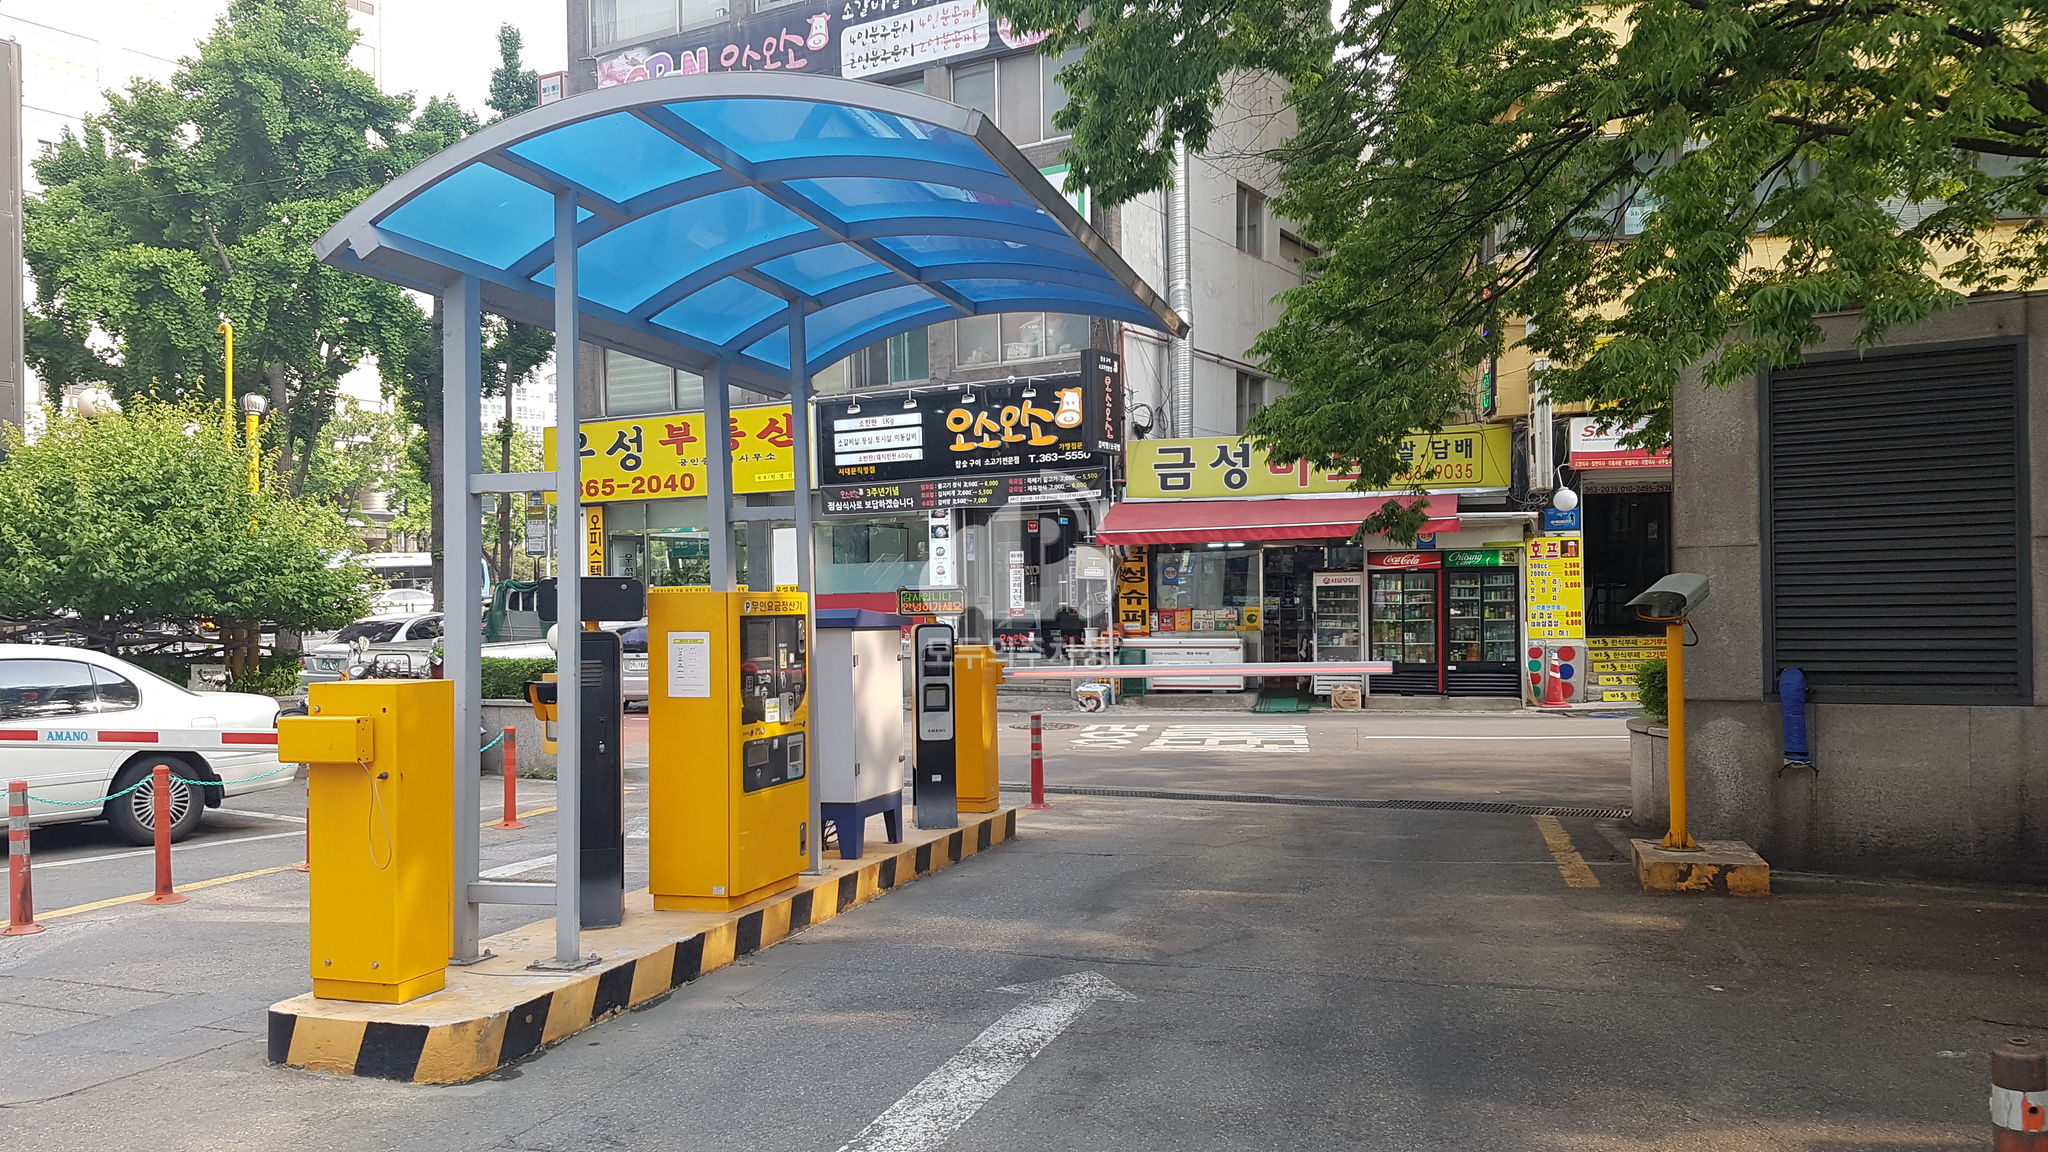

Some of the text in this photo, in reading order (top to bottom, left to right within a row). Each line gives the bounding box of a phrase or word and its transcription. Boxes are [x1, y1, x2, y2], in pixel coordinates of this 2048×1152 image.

[850, 17, 914, 46] 4인분주문시
[850, 44, 915, 70] 2인분주문시
[946, 400, 1058, 451] 오소오소
[580, 472, 695, 498] 65-2040
[866, 486, 900, 497] 3주년기념
[827, 498, 914, 511] 점심식사로 보답하겠습니다
[1529, 540, 1559, 559] 호프
[1449, 552, 1483, 564] Chilsung
[903, 592, 953, 602] 감사합니다
[752, 600, 804, 612] 무인요금정산기
[903, 601, 962, 612] 안녕히가세요
[47, 731, 88, 742] AMANO
